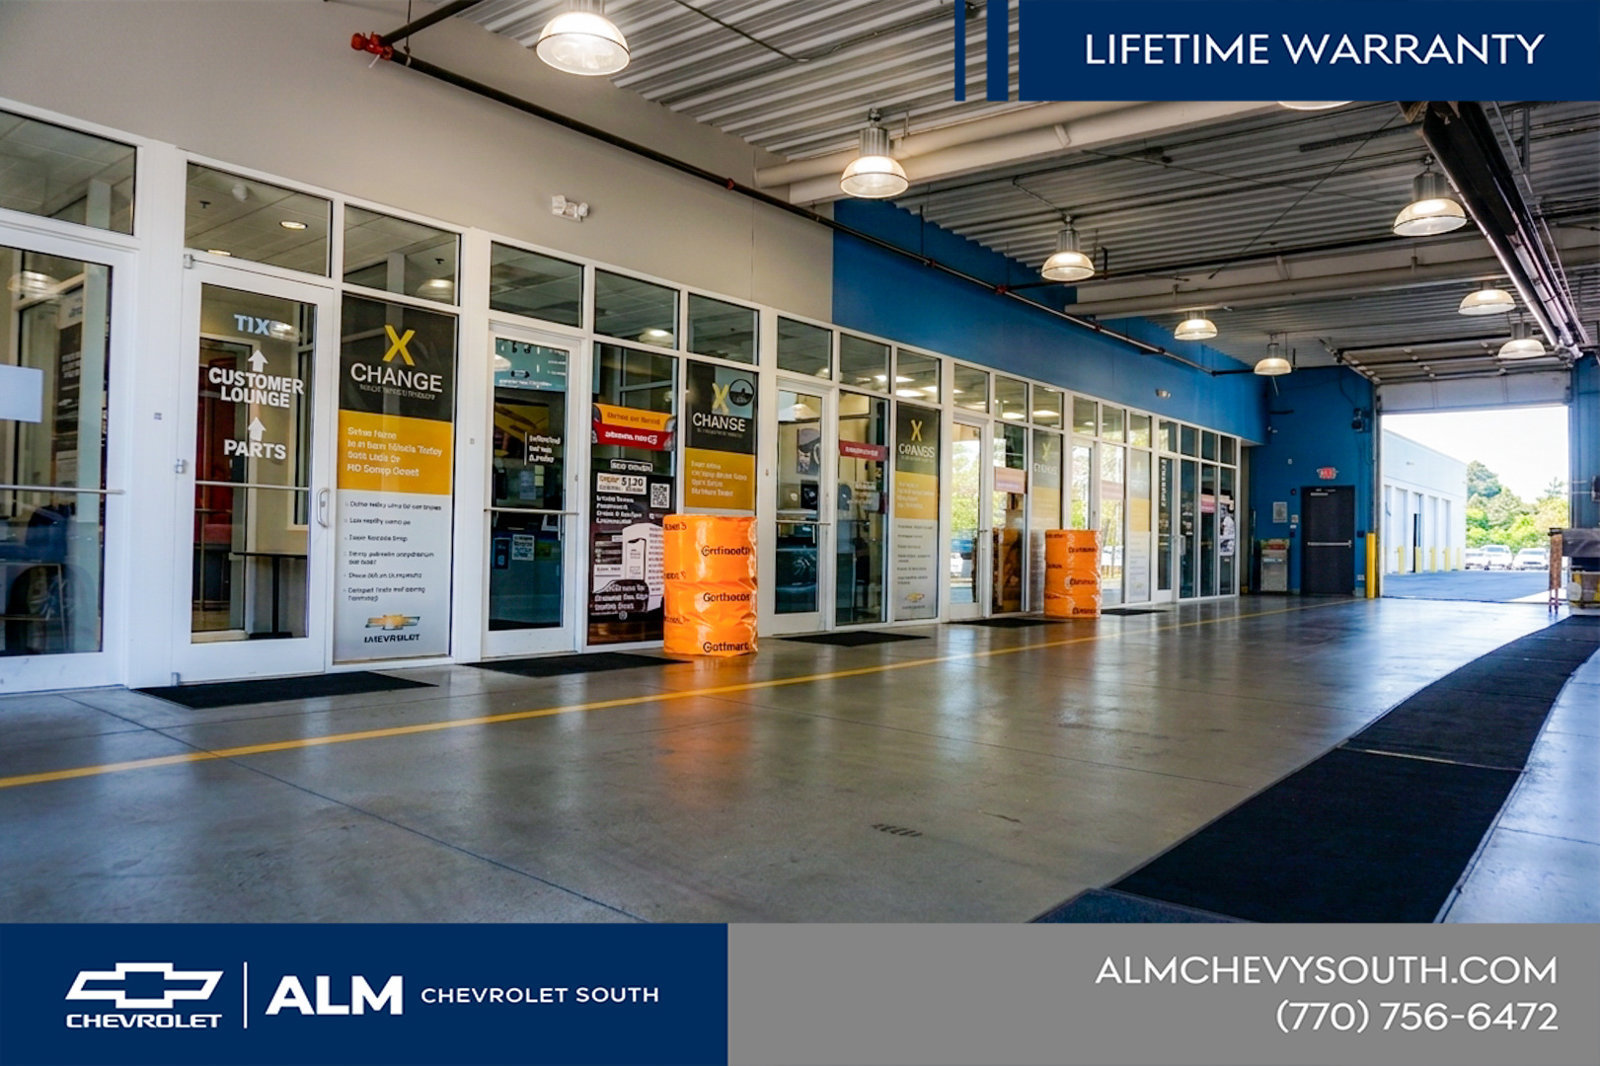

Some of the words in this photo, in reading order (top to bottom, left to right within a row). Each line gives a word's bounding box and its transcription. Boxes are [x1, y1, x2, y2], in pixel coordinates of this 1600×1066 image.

[382, 324, 416, 367] X
[208, 366, 304, 395] CUSTOMER
[350, 362, 444, 393] CHANGE
[220, 385, 290, 408] LOUNGE
[223, 438, 287, 460] PARTS
